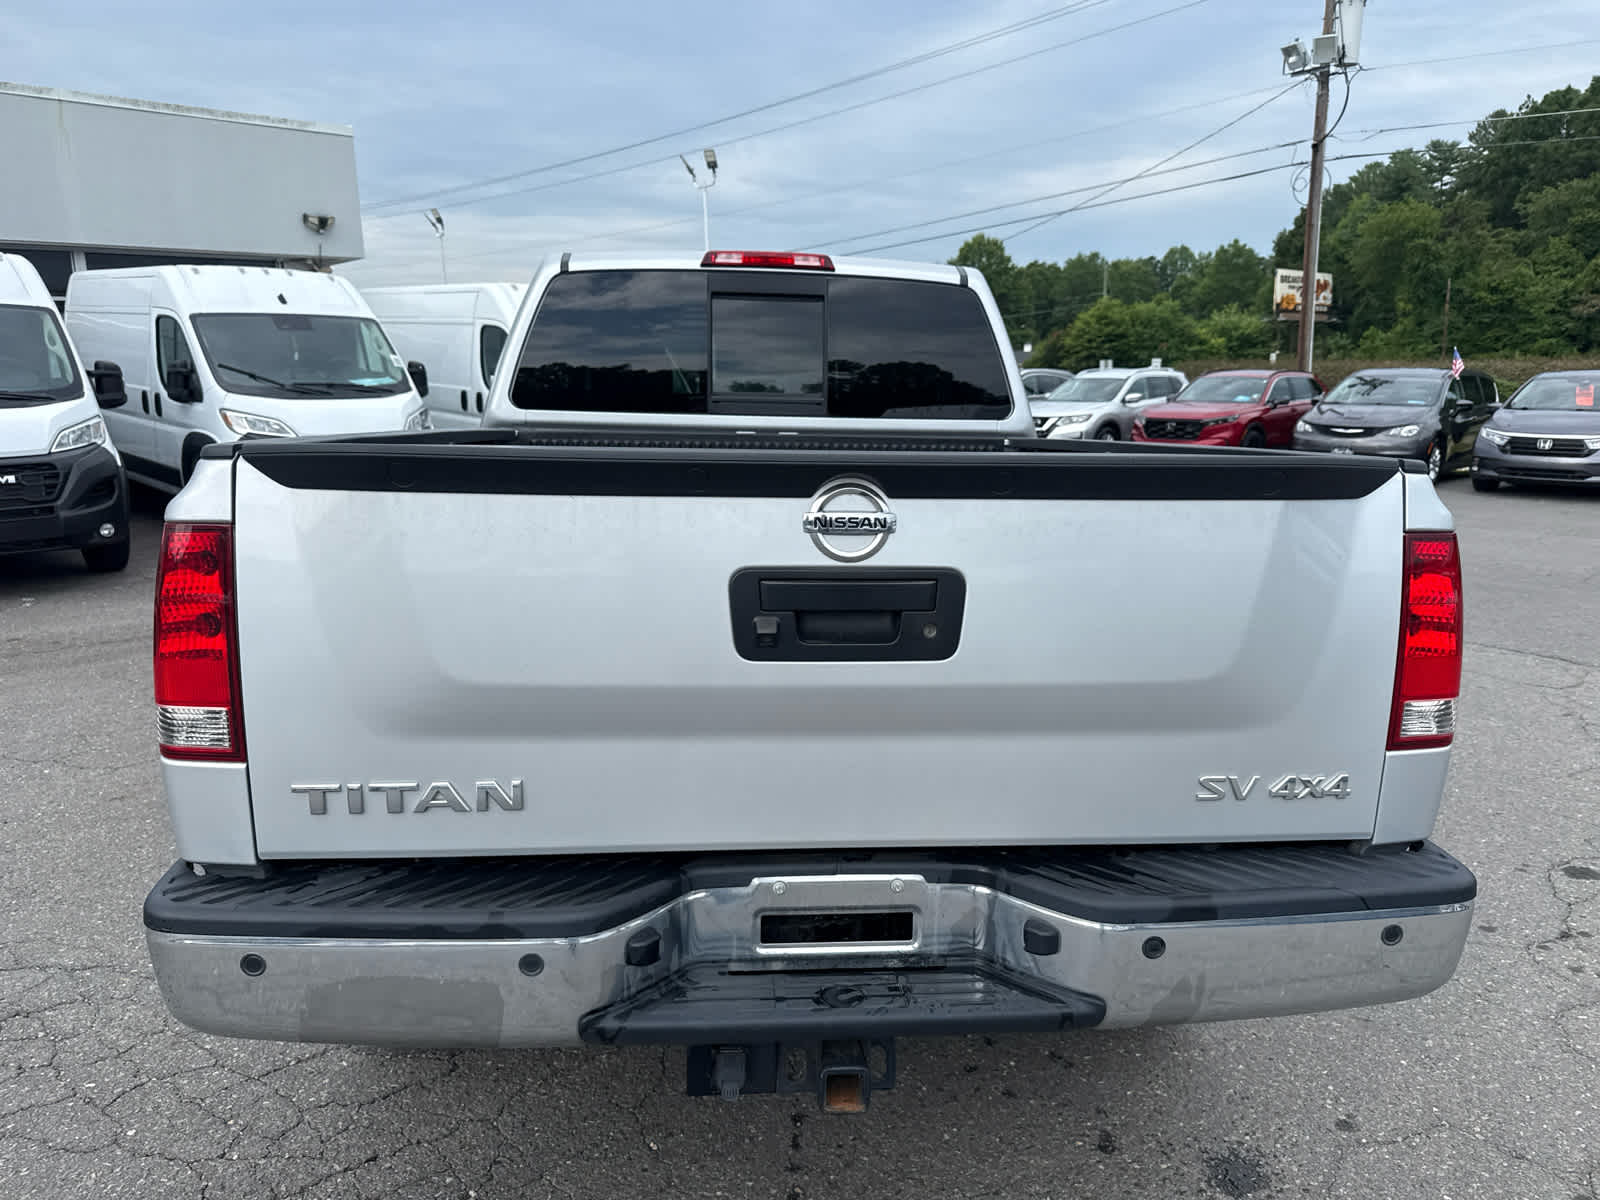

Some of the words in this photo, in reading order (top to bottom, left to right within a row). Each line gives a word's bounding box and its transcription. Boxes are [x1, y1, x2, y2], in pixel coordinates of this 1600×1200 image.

[813, 516, 887, 529] NISSAN
[290, 780, 524, 815] TITAN
[1196, 775, 1260, 801] SV
